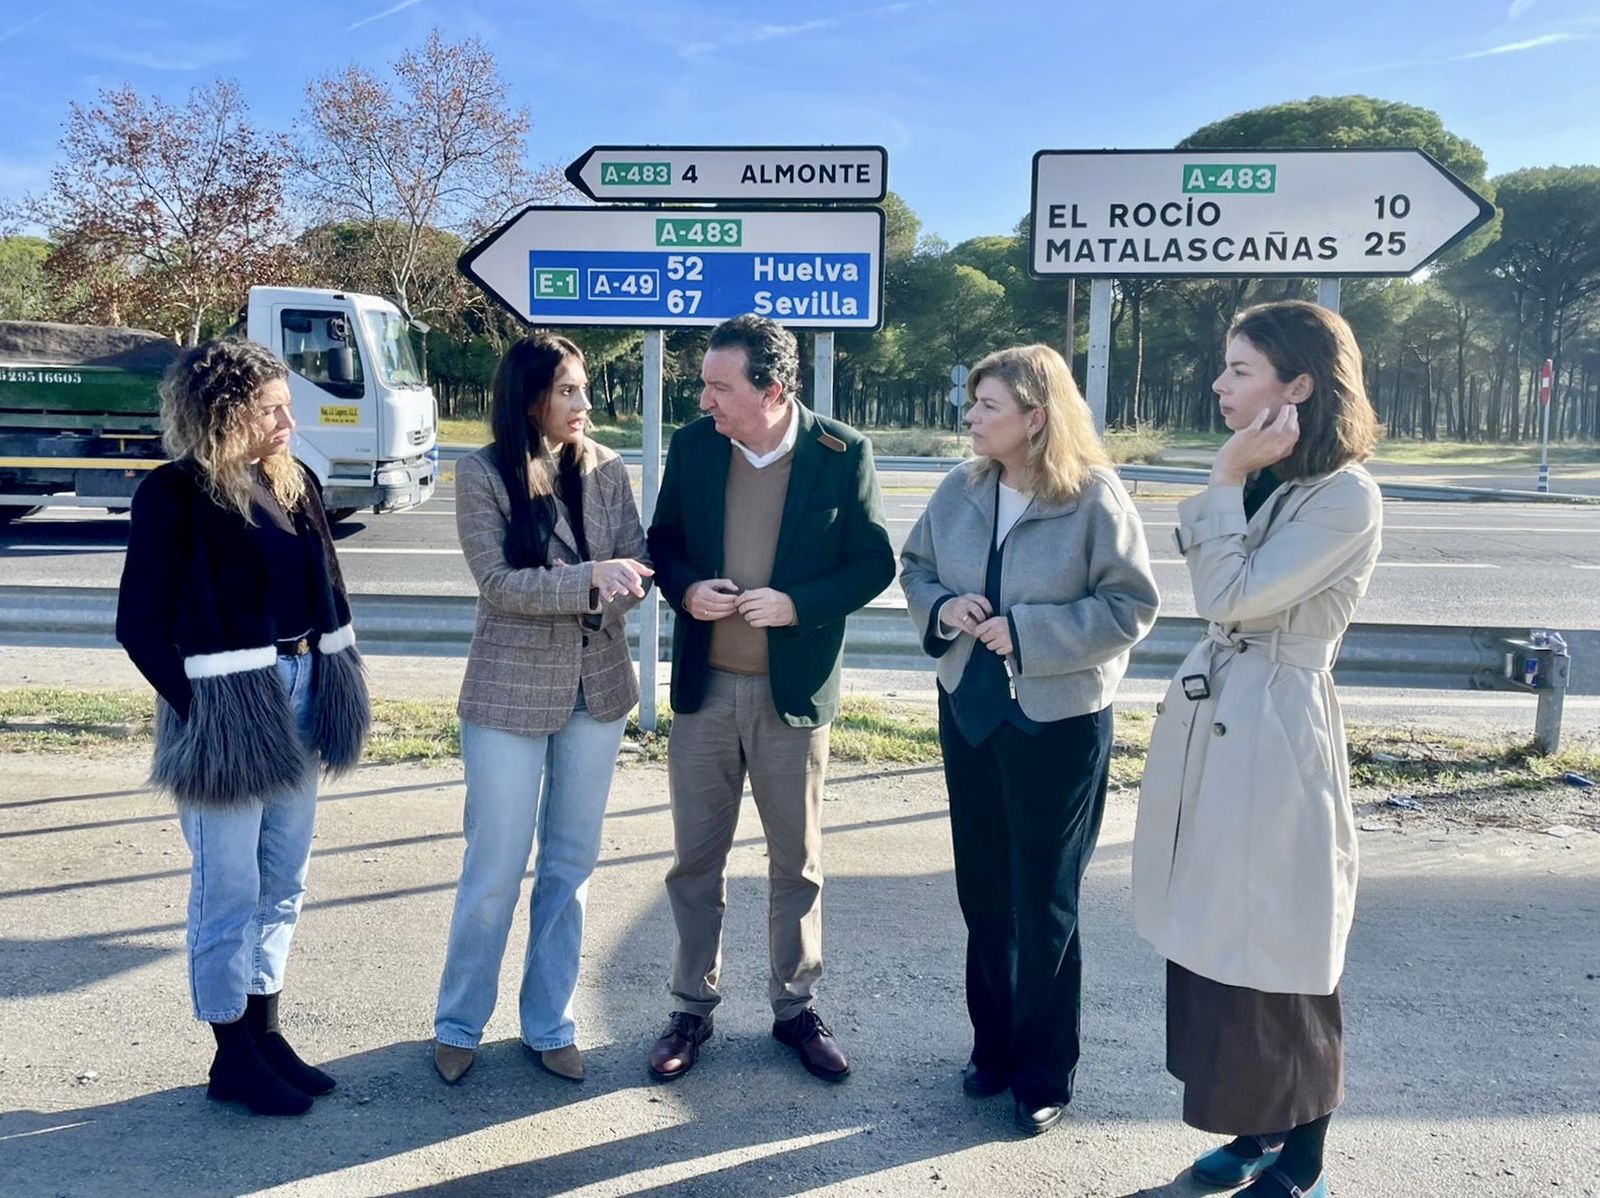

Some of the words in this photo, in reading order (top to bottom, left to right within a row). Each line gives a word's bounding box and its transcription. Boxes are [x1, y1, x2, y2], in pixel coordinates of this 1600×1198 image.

[604, 165, 669, 183] A-483
[681, 164, 698, 184] 4
[740, 164, 871, 184] ALMONTE
[1187, 167, 1272, 190] A-483
[1049, 204, 1087, 228] EL
[1109, 197, 1221, 228] ROCÍO
[1374, 194, 1411, 219] 10
[660, 222, 739, 243] A-483
[1046, 231, 1339, 263] MATALASCAÑAS
[1364, 231, 1406, 256] 25
[667, 255, 704, 281] 52
[754, 257, 859, 282] Huelva
[539, 273, 575, 294] E-1
[594, 274, 654, 295] A-49
[667, 289, 702, 315] 67
[753, 291, 858, 316] Sevilla
